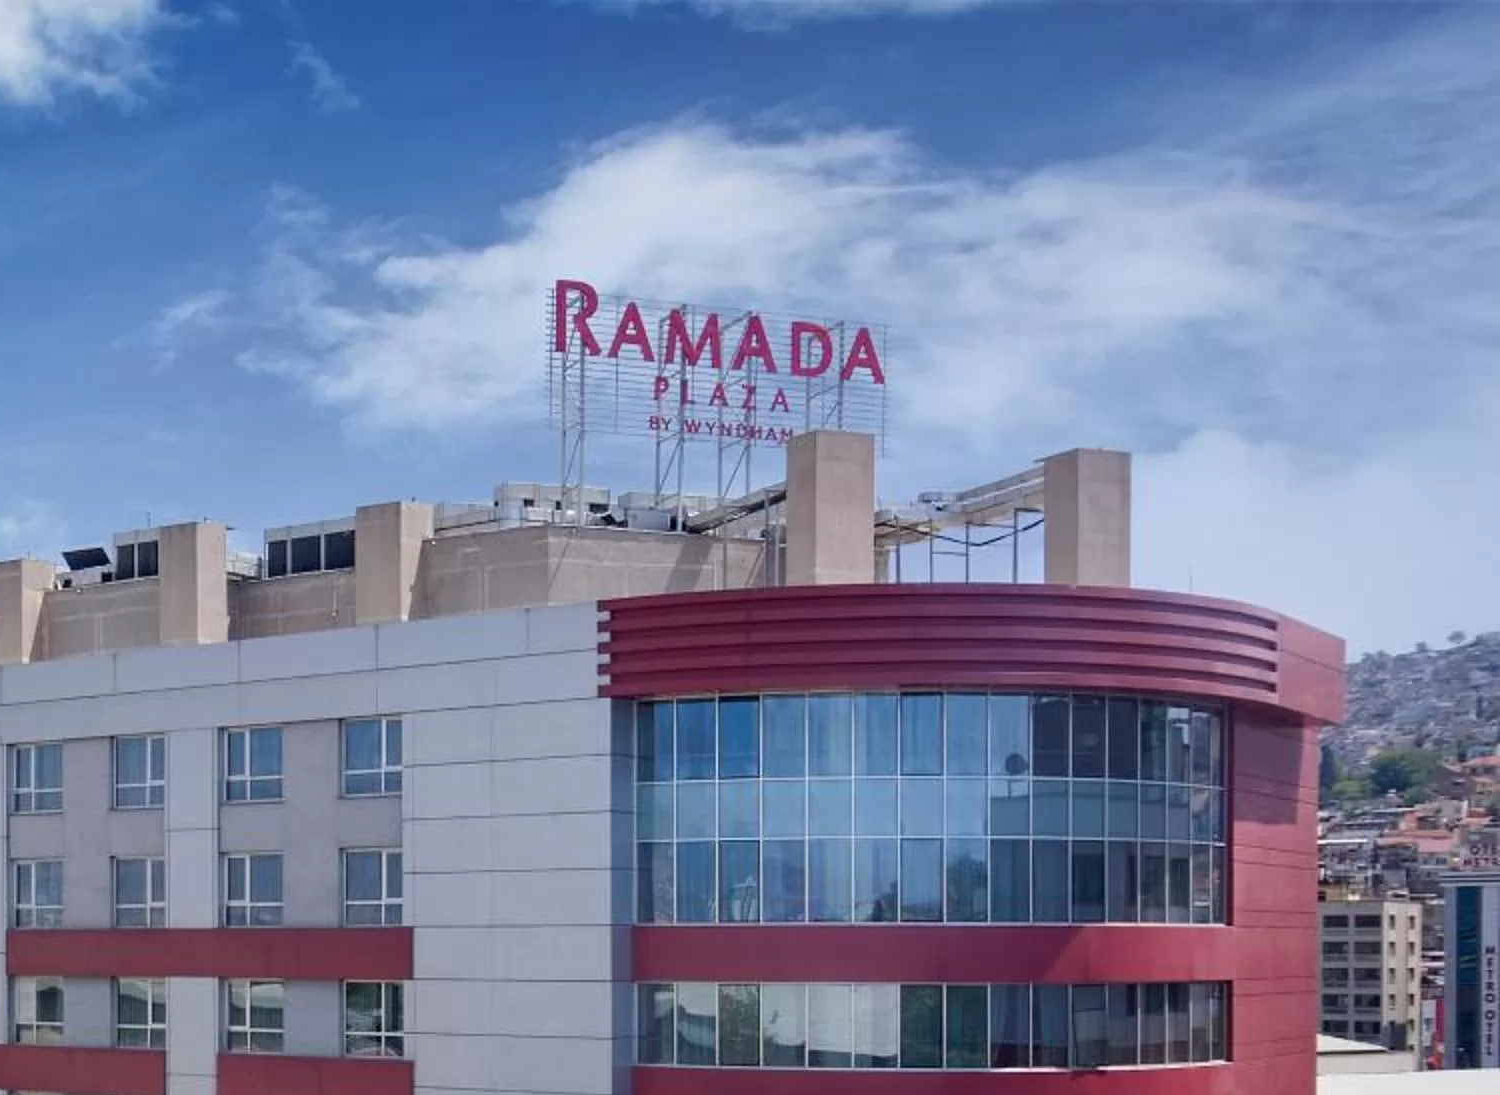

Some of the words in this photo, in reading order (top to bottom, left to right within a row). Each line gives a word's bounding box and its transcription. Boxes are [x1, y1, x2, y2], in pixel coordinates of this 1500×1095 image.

[555, 279, 885, 384] RAMADA
[654, 376, 790, 412] PLAZA
[649, 415, 672, 431] BY
[683, 419, 793, 443] WYNDHAM
[1485, 946, 1496, 1003] METRO
[1485, 1009, 1496, 1056] OTEL
